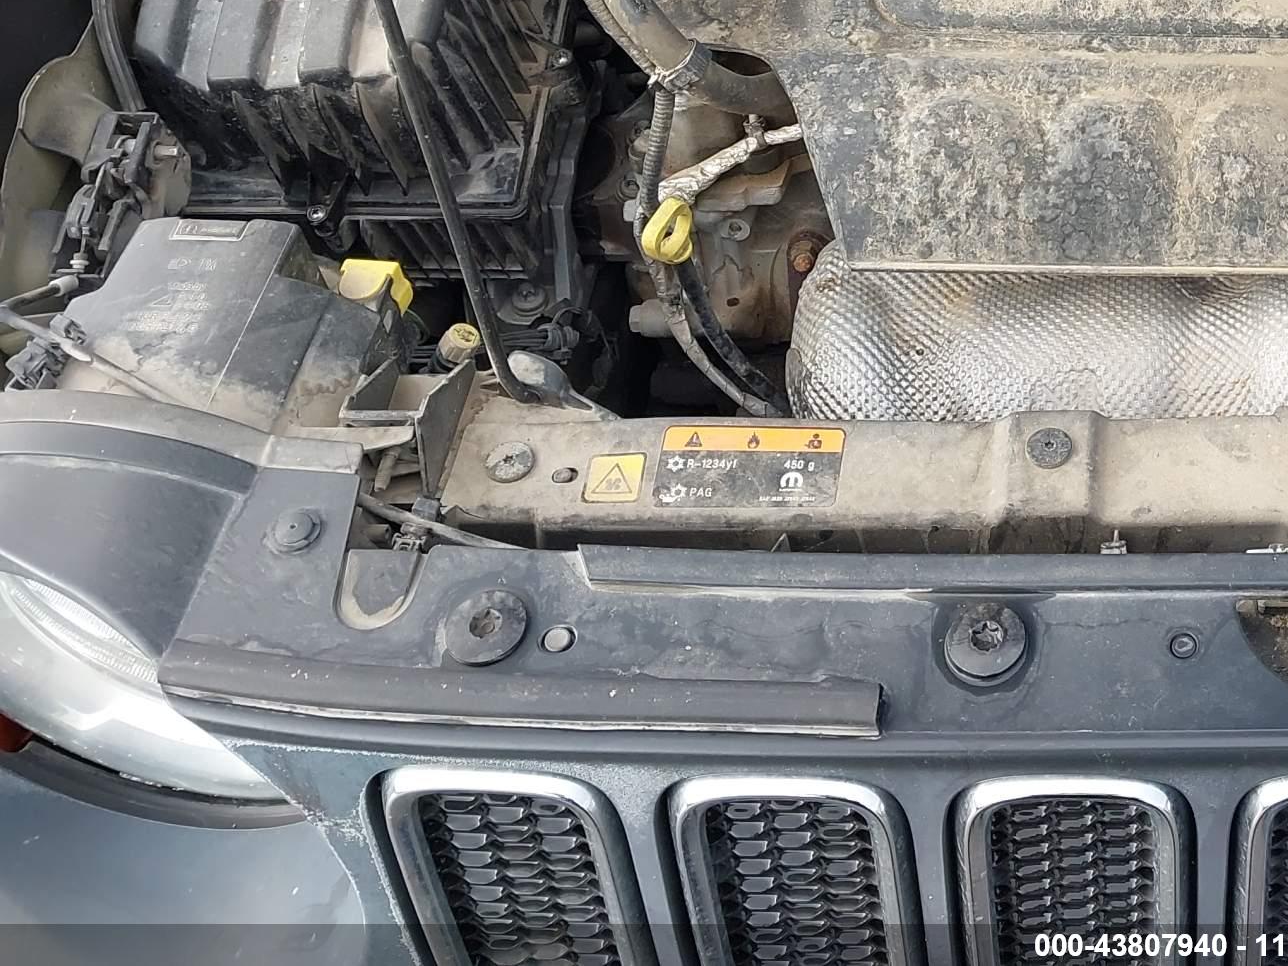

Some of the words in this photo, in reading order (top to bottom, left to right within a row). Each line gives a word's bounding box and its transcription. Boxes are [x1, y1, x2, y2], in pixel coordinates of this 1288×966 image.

[686, 458, 738, 471] R-1234yf
[783, 459, 805, 470] 450
[807, 461, 815, 472] g
[689, 487, 713, 498] PAG
